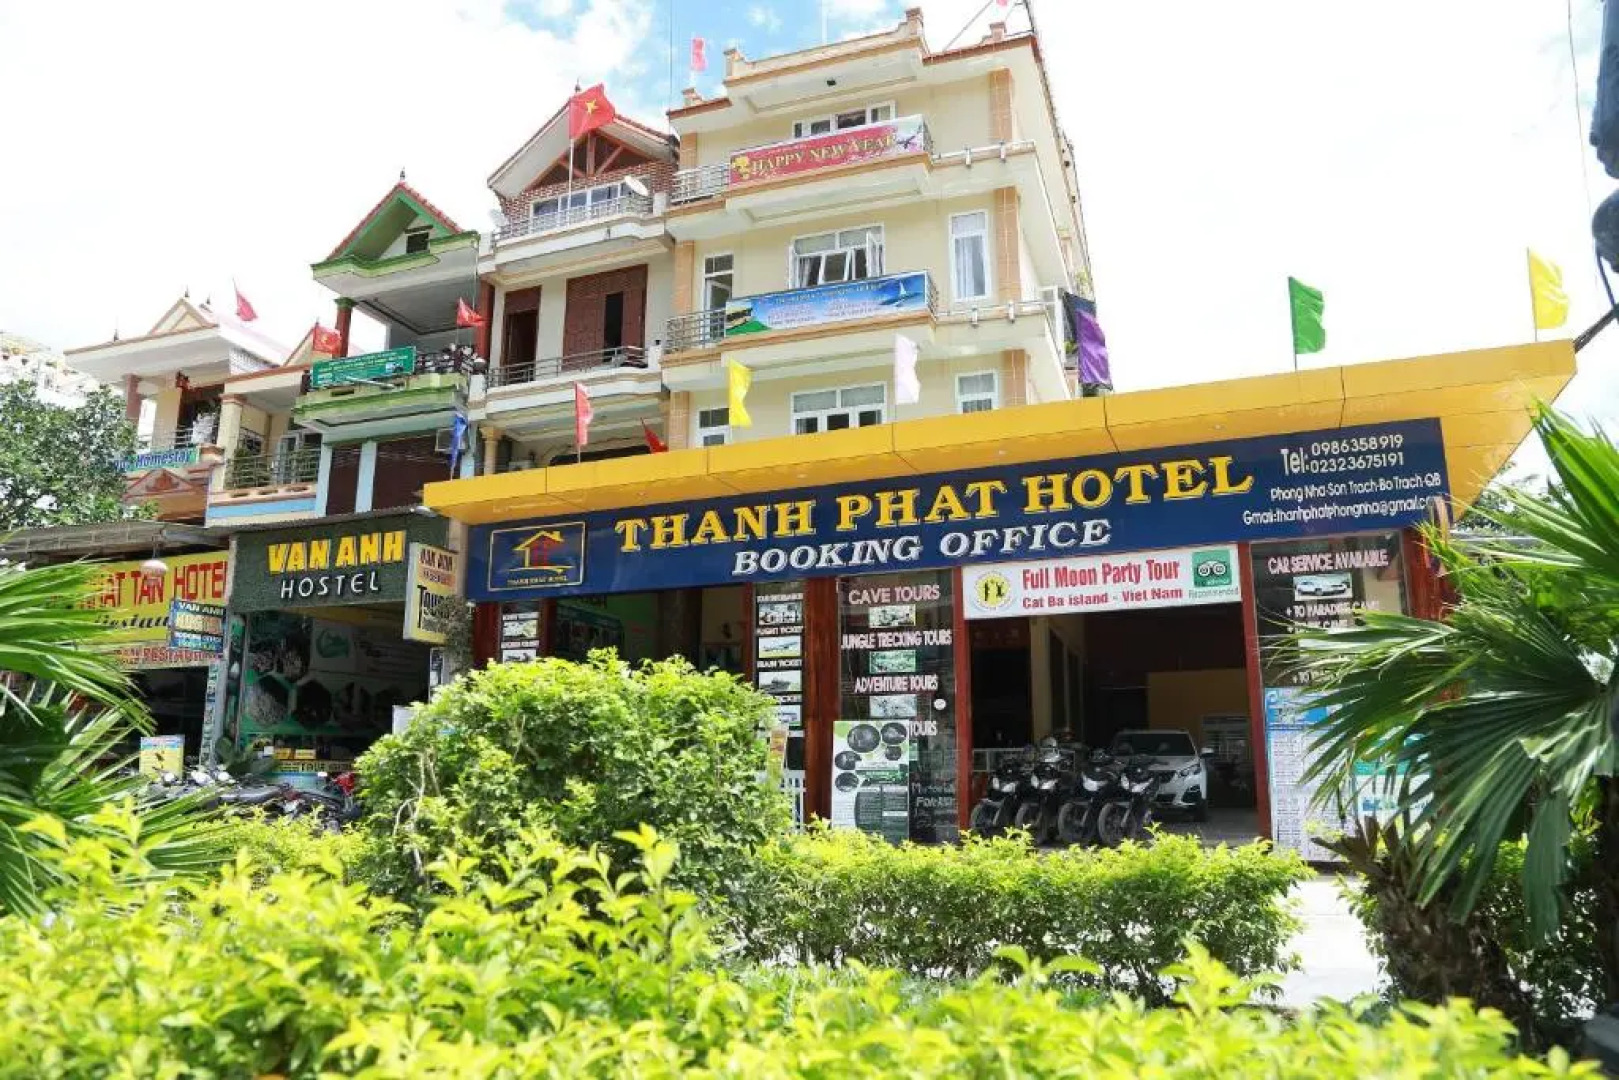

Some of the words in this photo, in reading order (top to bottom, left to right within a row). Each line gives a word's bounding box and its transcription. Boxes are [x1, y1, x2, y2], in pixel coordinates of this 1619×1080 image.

[752, 151, 802, 173] HAPPY
[810, 145, 845, 162] NEW
[614, 499, 817, 552] THANH
[835, 481, 1008, 531] PHAT
[1021, 456, 1254, 514] HOTEL
[268, 539, 331, 574] VAN
[334, 530, 406, 567] ANH
[732, 535, 922, 576] BOOKING
[939, 518, 1113, 559] OFFICE
[1291, 553, 1333, 572] SERVICE
[1335, 549, 1388, 569] AVAILABLE
[280, 571, 379, 599] HOSTEL
[1022, 568, 1049, 590] Full
[1054, 566, 1097, 587] Moon
[1102, 562, 1142, 584] Party
[1146, 559, 1180, 580] Tour
[848, 587, 891, 605] CAVE
[894, 584, 940, 602] TOURS
[1023, 597, 1044, 609] Cat
[1048, 595, 1065, 607] Ba
[1122, 589, 1147, 602] Viet
[1151, 587, 1183, 599] Nam
[841, 633, 876, 649] JUNGLE
[923, 629, 952, 646] TOURS
[854, 676, 908, 693] ADVENTURE
[909, 674, 938, 691] TOURS
